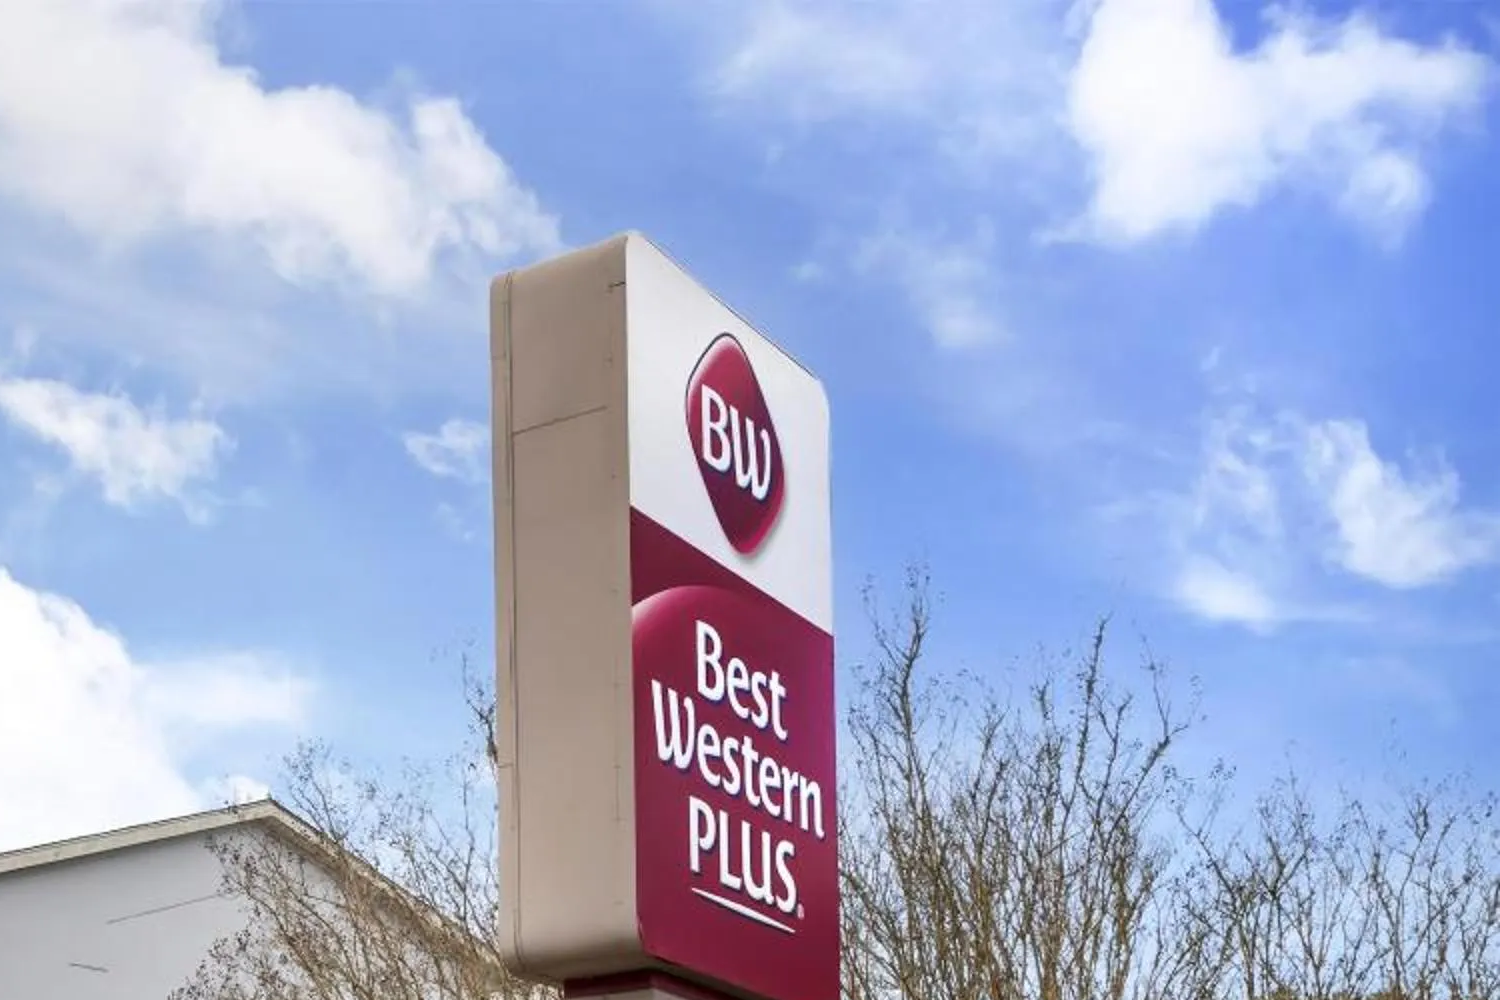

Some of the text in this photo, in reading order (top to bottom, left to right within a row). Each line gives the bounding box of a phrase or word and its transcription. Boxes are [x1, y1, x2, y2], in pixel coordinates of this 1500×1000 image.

[702, 384, 771, 500] BW
[695, 619, 788, 740] Best
[651, 678, 825, 838] Western
[689, 796, 798, 914] PLUS
